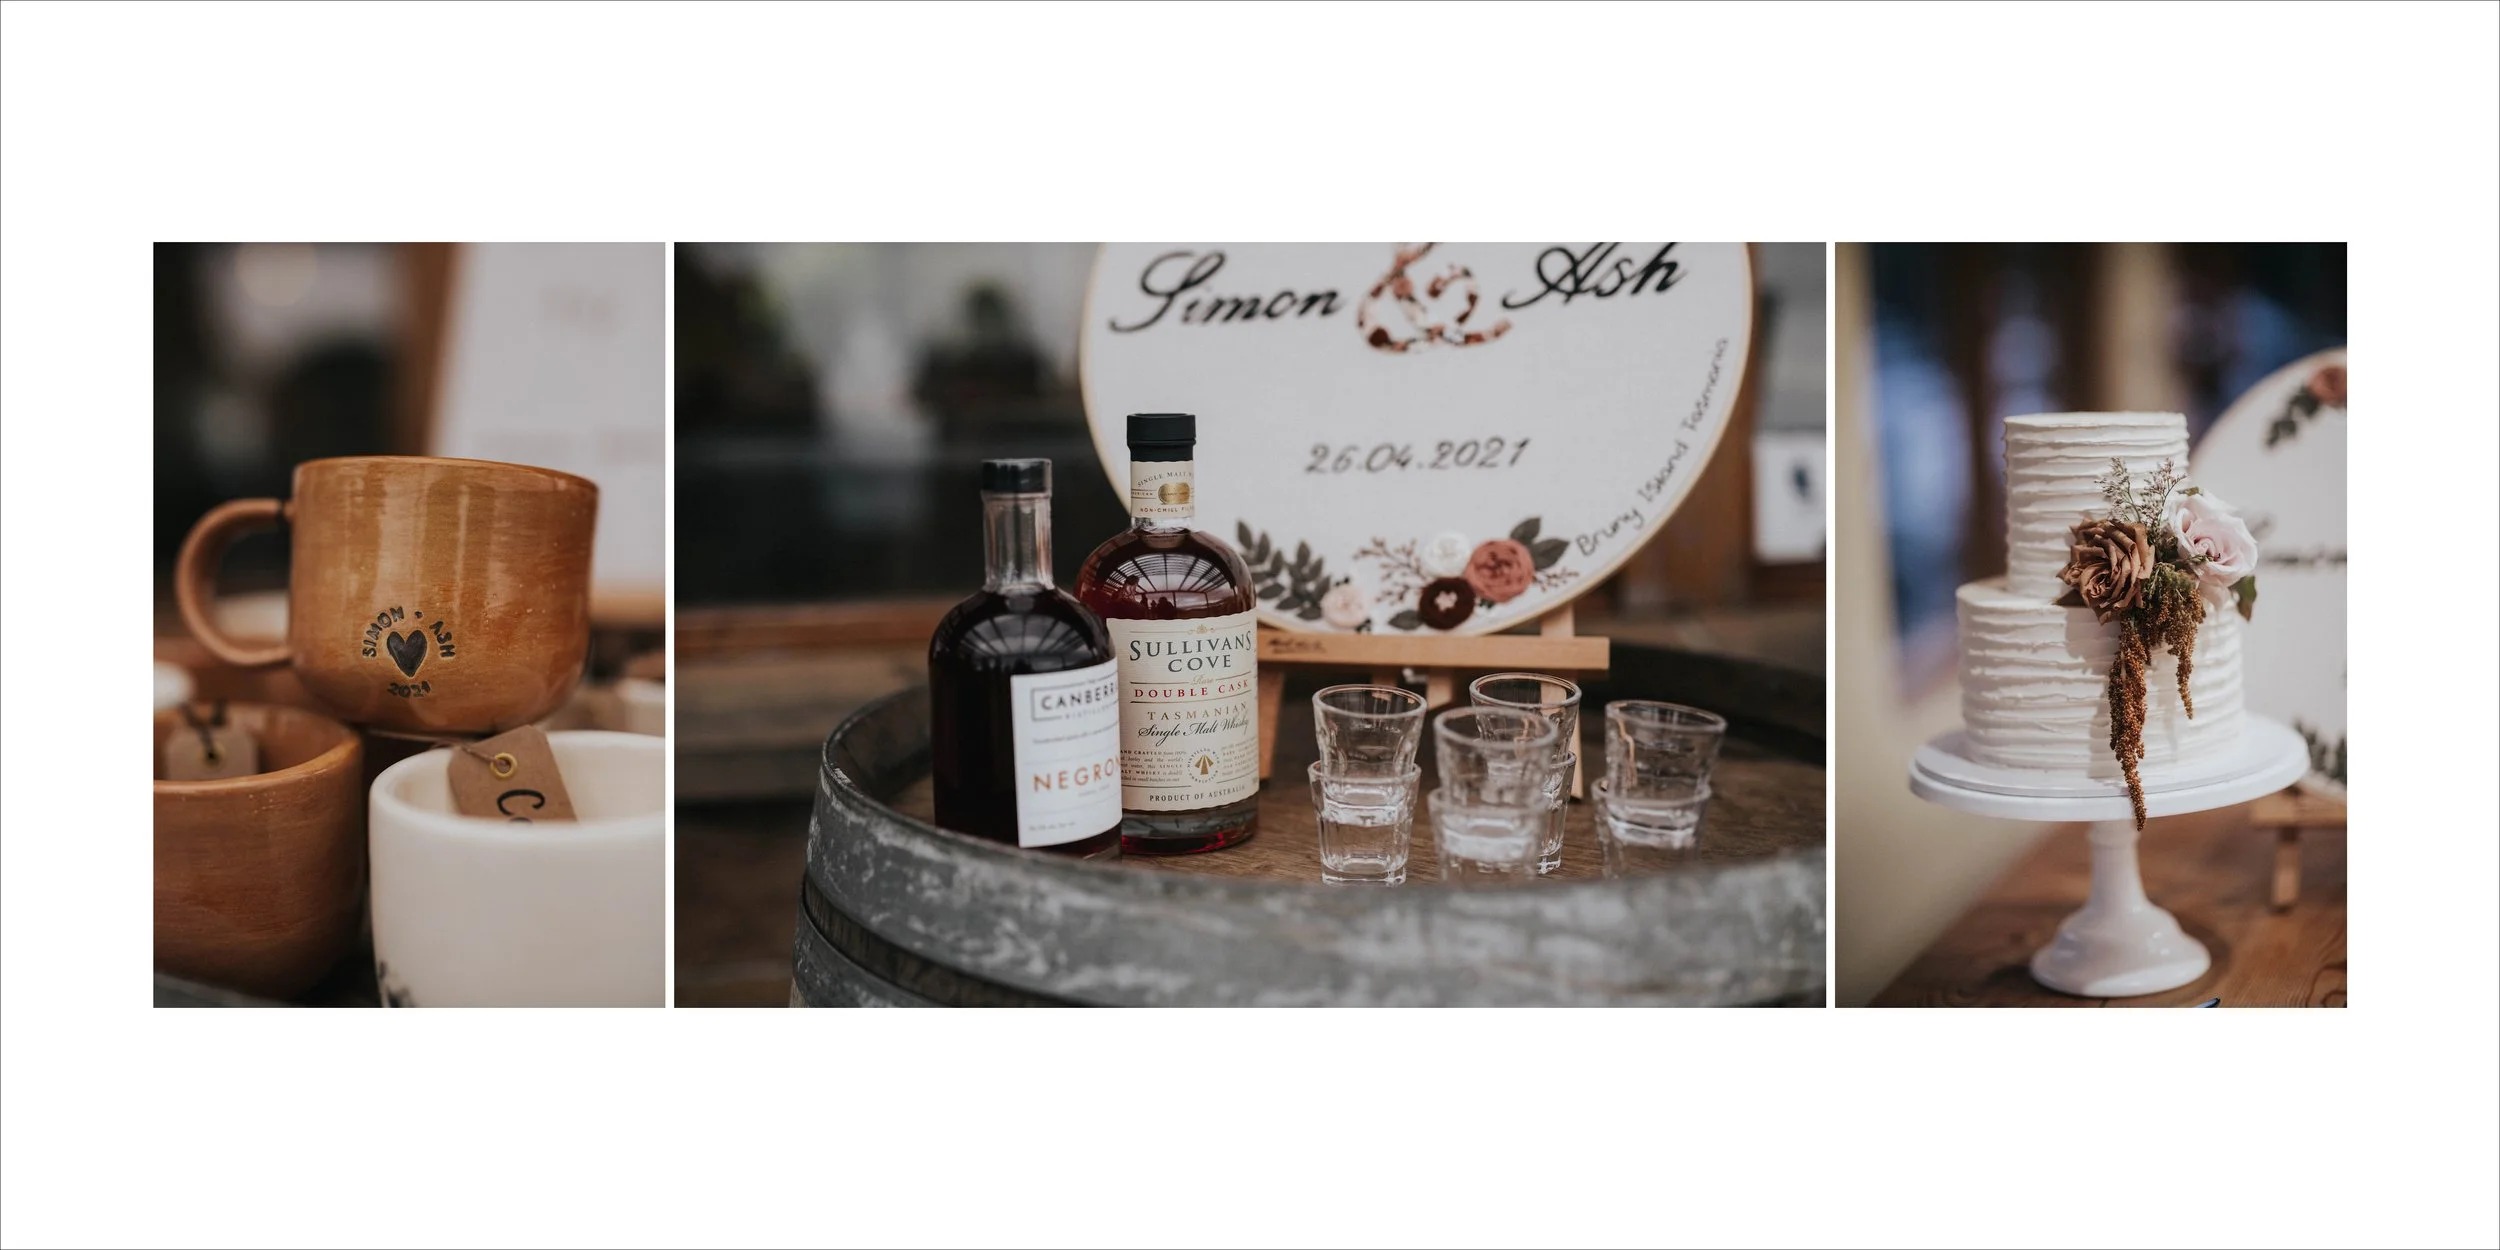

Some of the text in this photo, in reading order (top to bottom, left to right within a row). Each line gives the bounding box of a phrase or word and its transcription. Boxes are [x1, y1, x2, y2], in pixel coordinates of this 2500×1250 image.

[1108, 250, 1345, 333] Simon
[1502, 242, 1689, 309] Ash
[1305, 435, 1532, 475] 26.04.2021
[1575, 337, 1729, 557] Bruny Island Tasmania
[362, 606, 456, 658] SIMON ASH
[1129, 630, 1252, 661] SULLIVANS
[1167, 654, 1232, 673] COVE
[1134, 679, 1249, 698] DOUBLE CASK
[1147, 701, 1248, 720] TASMANIAN
[1138, 723, 1181, 747] Single
[1182, 719, 1219, 737] Malt
[1149, 785, 1246, 802] PRODUCT OF AUSTRALIA
